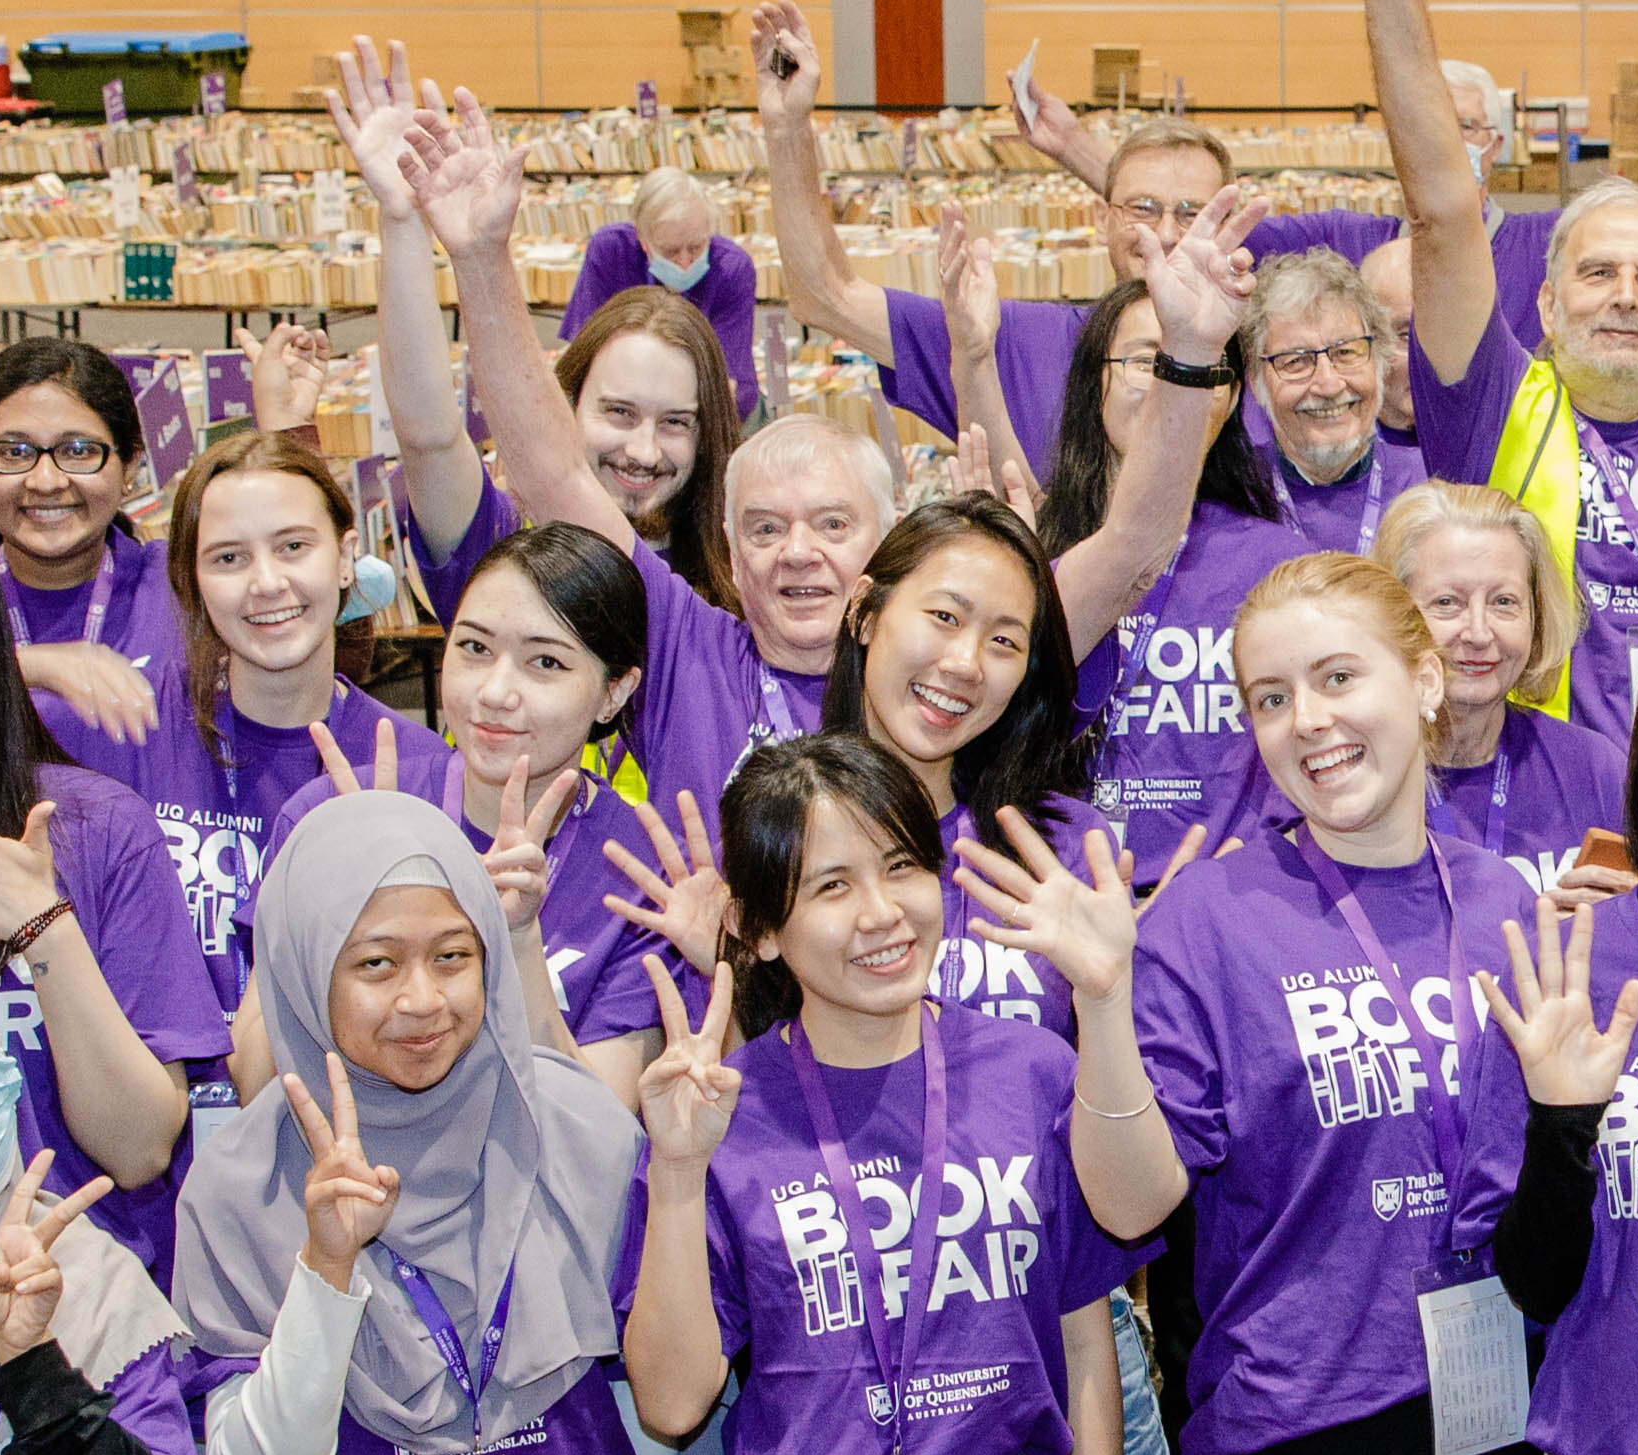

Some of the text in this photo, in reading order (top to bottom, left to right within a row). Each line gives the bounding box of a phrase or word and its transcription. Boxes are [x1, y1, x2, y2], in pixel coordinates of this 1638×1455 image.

[1614, 584, 1629, 602] THE
[1113, 683, 1246, 736] FAIR
[1124, 777, 1202, 791] THE UNIVERSITY
[1123, 789, 1202, 803] OF QUEENSLAND
[155, 801, 263, 833] UQ ALUMNI
[1281, 972, 1317, 992] UQ
[771, 1178, 806, 1202] UQ
[1406, 1175, 1428, 1189] THE
[774, 1154, 1042, 1262] BOOK
[1406, 1190, 1423, 1206] OF
[879, 1229, 1040, 1321] FAIR
[932, 1364, 1011, 1389] UNIVERSITY
[903, 1378, 1011, 1410] OF QUEENSLAND
[907, 1402, 974, 1422] AUSTRALIA
